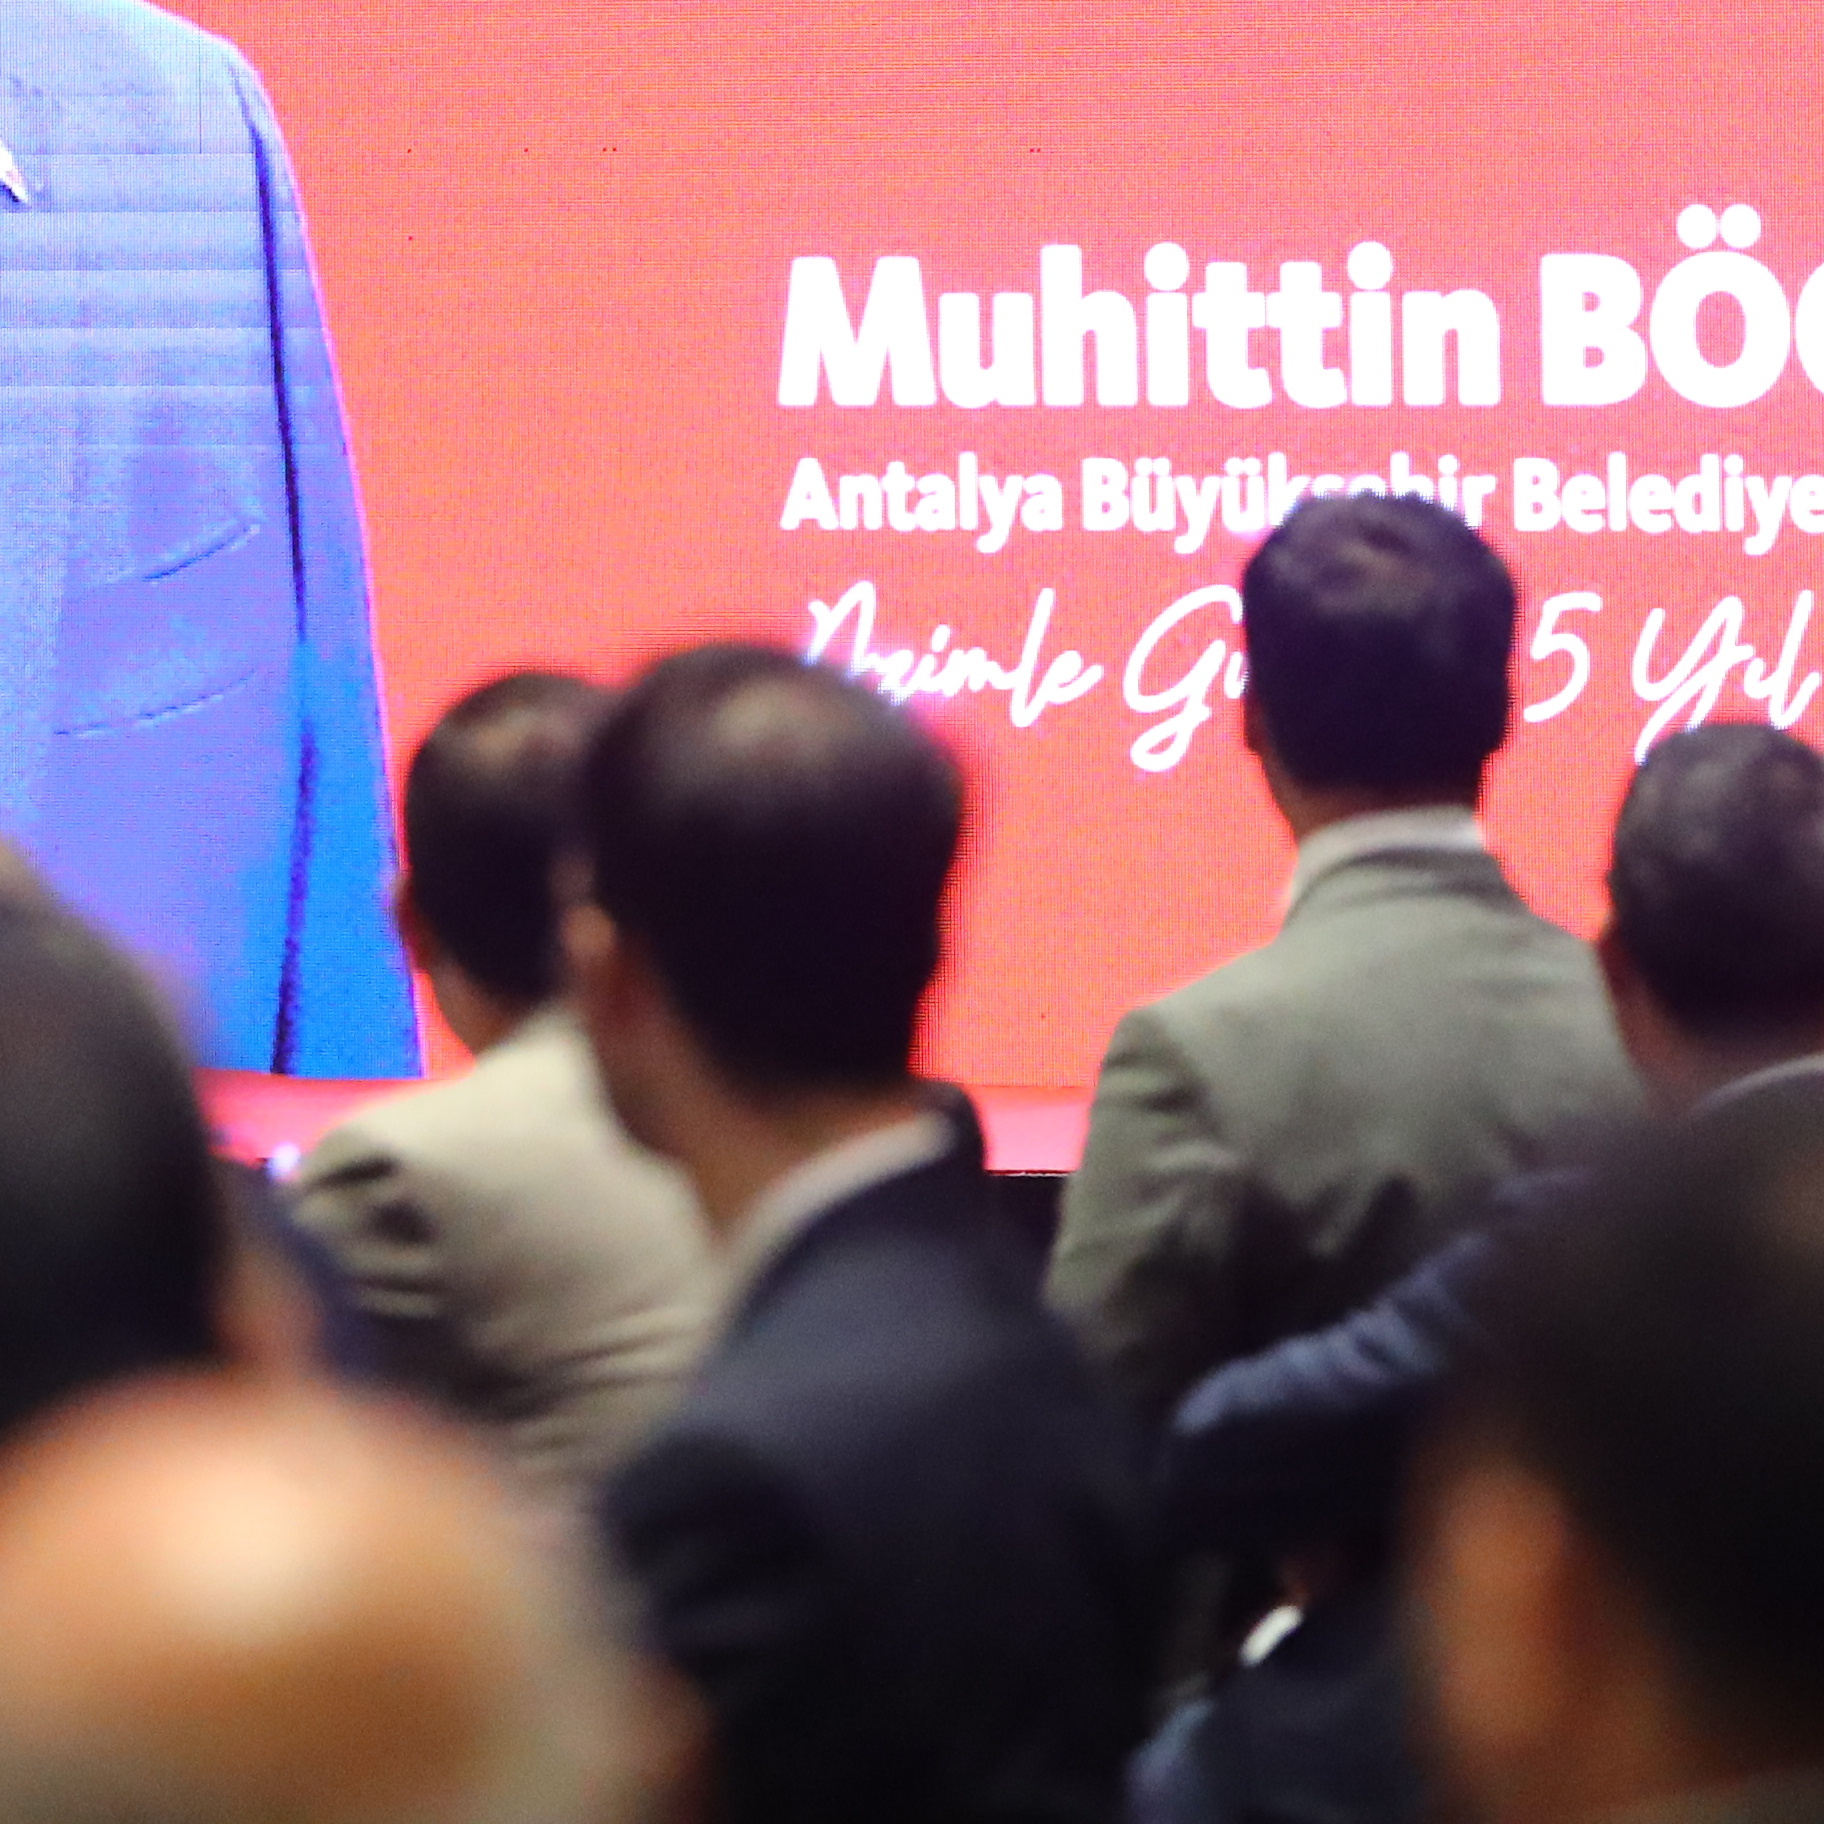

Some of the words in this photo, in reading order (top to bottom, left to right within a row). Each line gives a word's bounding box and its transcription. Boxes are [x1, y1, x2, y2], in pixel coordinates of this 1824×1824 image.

[777, 240, 1502, 410] Muhittin
[779, 450, 1064, 555] Antalya
[1522, 590, 1604, 724] 5
